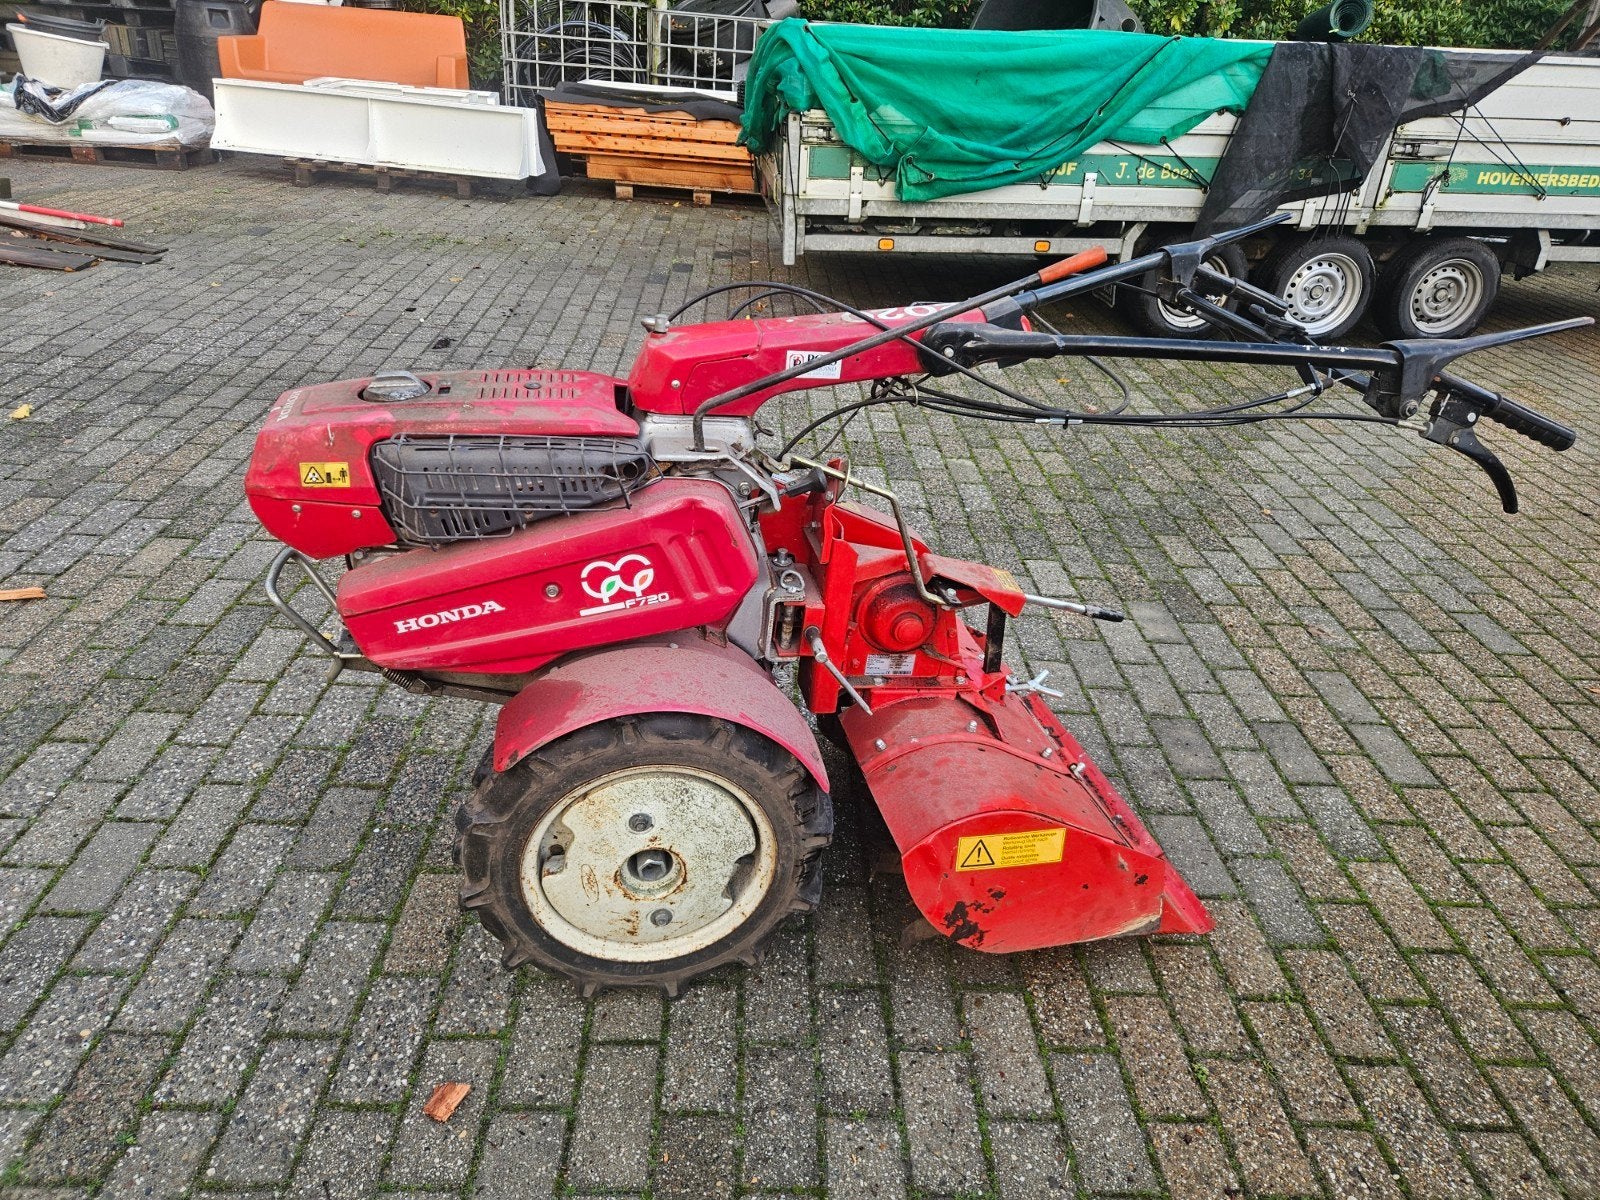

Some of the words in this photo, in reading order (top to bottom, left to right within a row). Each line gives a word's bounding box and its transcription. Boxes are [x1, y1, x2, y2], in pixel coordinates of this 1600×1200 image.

[1115, 162, 1130, 179] J.
[1138, 163, 1155, 179] de
[1161, 163, 1198, 179] Boer
[1477, 172, 1600, 188] HOVENIERSBED
[624, 592, 670, 610] F720
[394, 600, 506, 634] HONDA
